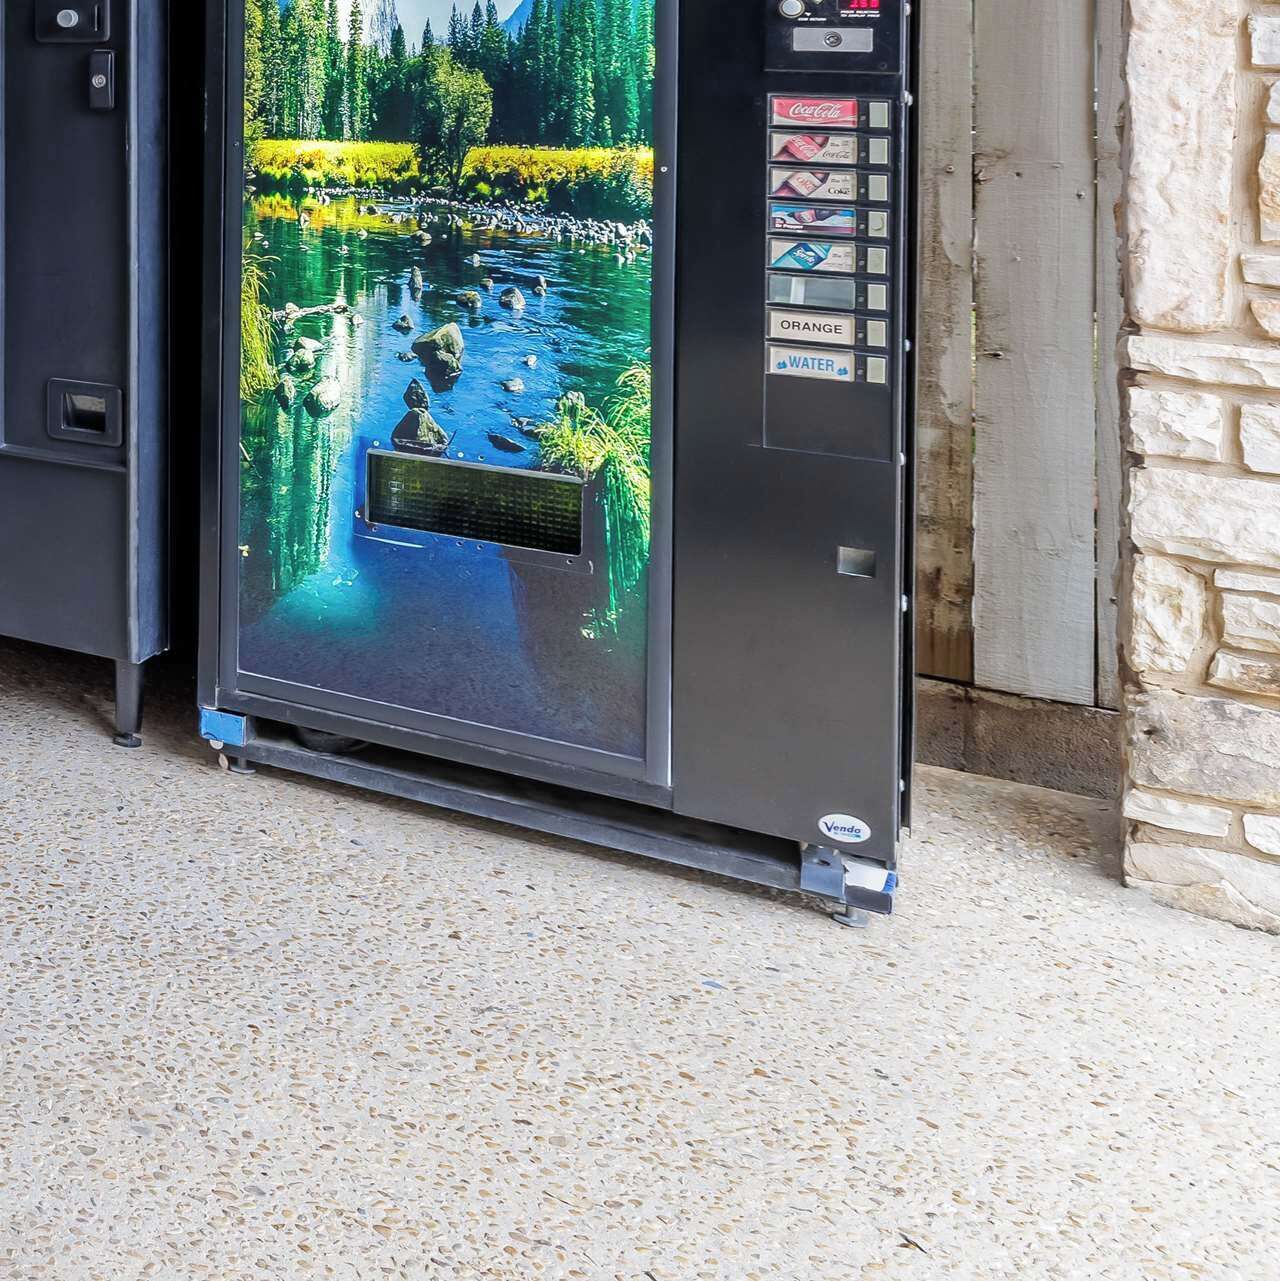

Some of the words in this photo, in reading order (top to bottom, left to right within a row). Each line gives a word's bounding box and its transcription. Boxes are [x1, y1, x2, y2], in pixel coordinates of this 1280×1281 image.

[780, 319, 844, 335] ORANGE
[788, 354, 835, 372] WATER
[821, 820, 862, 835] Vendo
